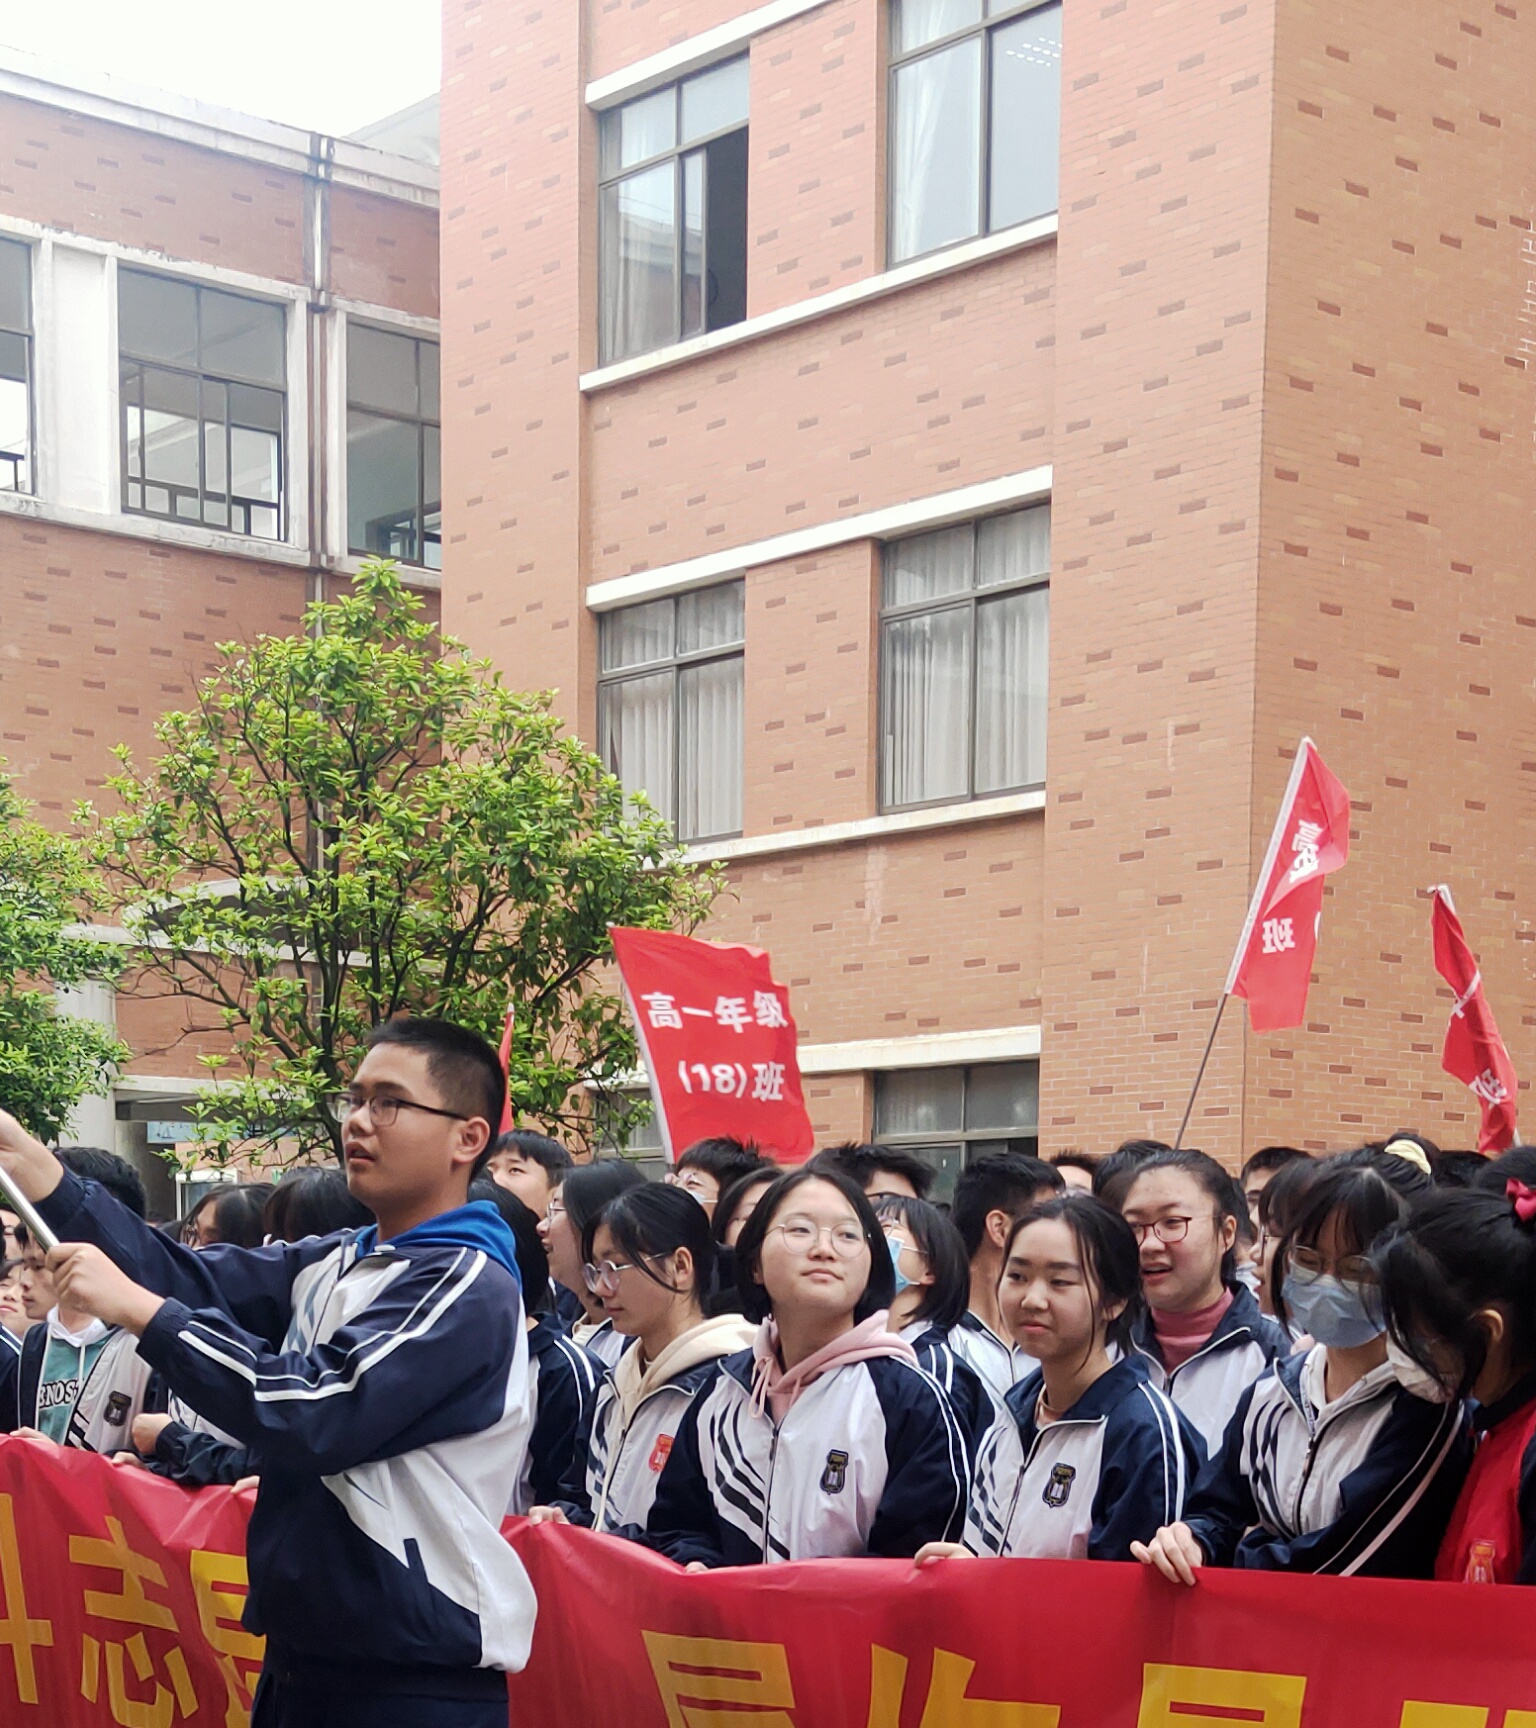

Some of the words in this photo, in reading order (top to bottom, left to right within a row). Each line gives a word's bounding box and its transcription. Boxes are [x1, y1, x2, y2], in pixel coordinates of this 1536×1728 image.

[640, 990, 790, 1034] 高一年级
[677, 1060, 786, 1102] (18)班
